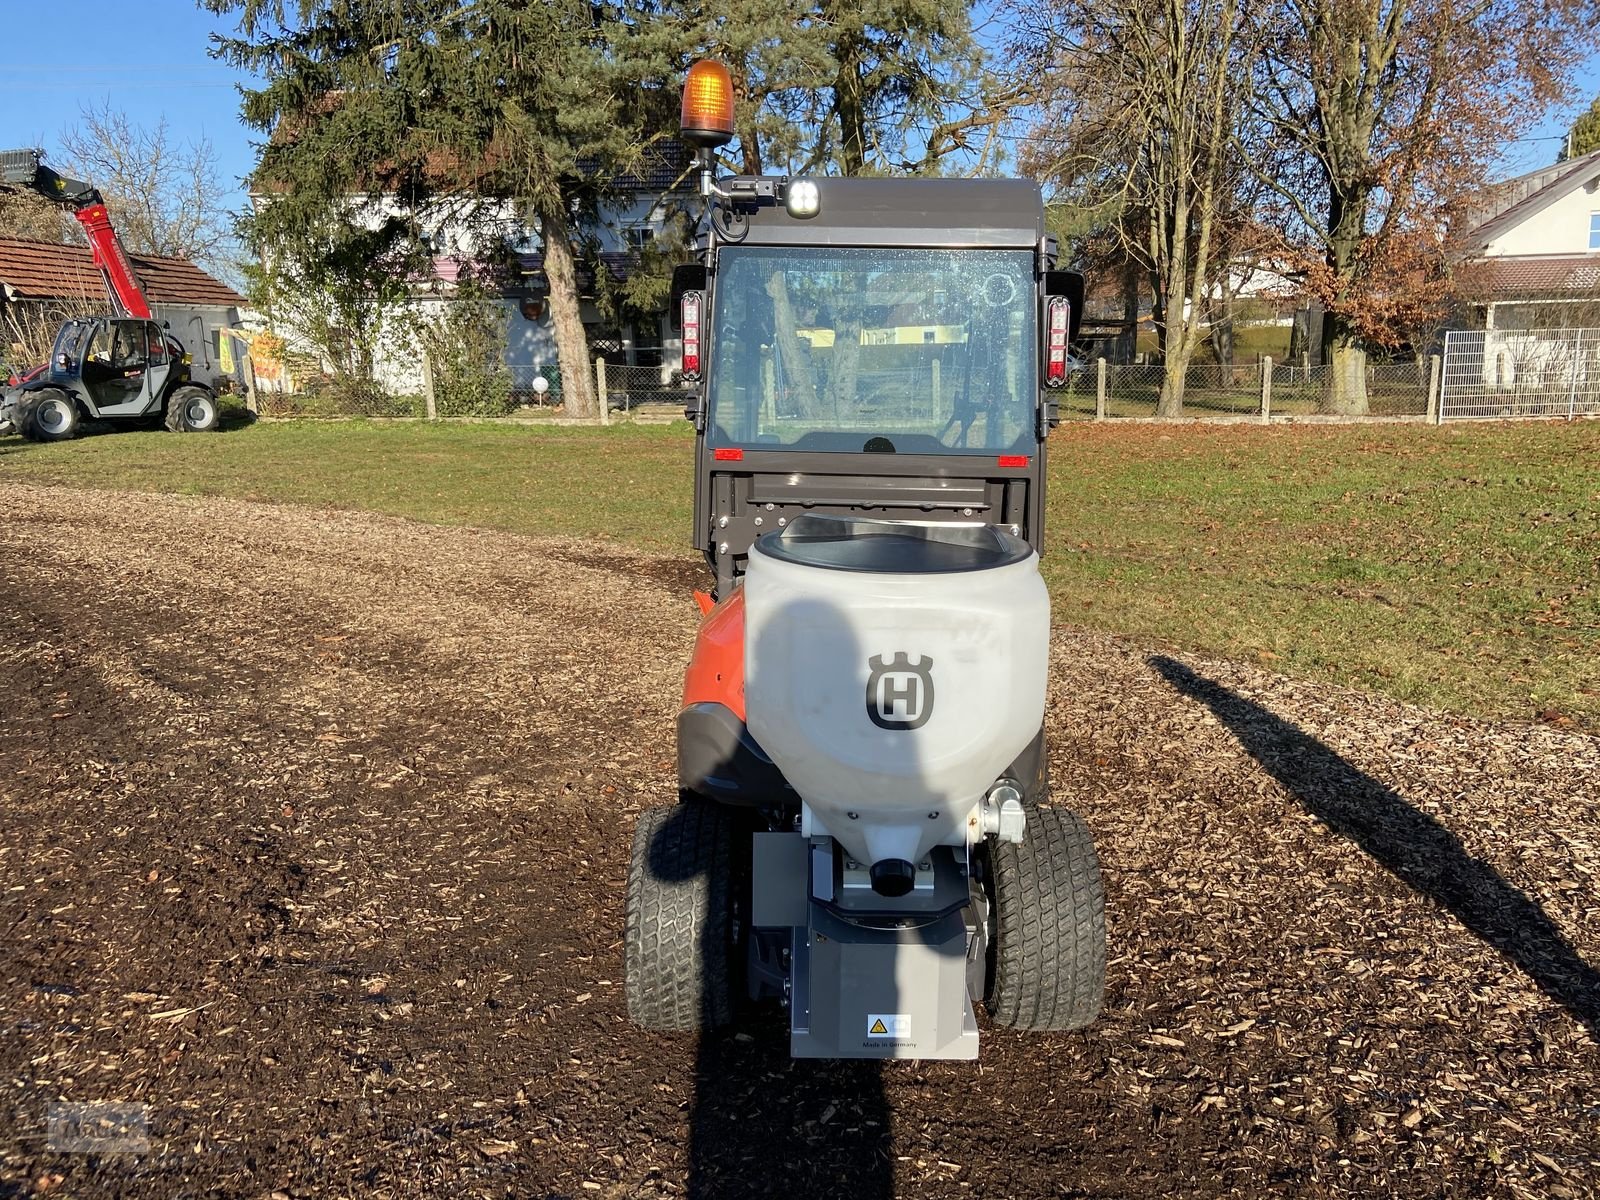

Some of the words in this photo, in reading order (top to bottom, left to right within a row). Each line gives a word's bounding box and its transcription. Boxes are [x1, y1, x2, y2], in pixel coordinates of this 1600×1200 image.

[111, 238, 138, 290] WEIDEMANN
[884, 677, 917, 715] H
[889, 1041, 917, 1049] Germany
